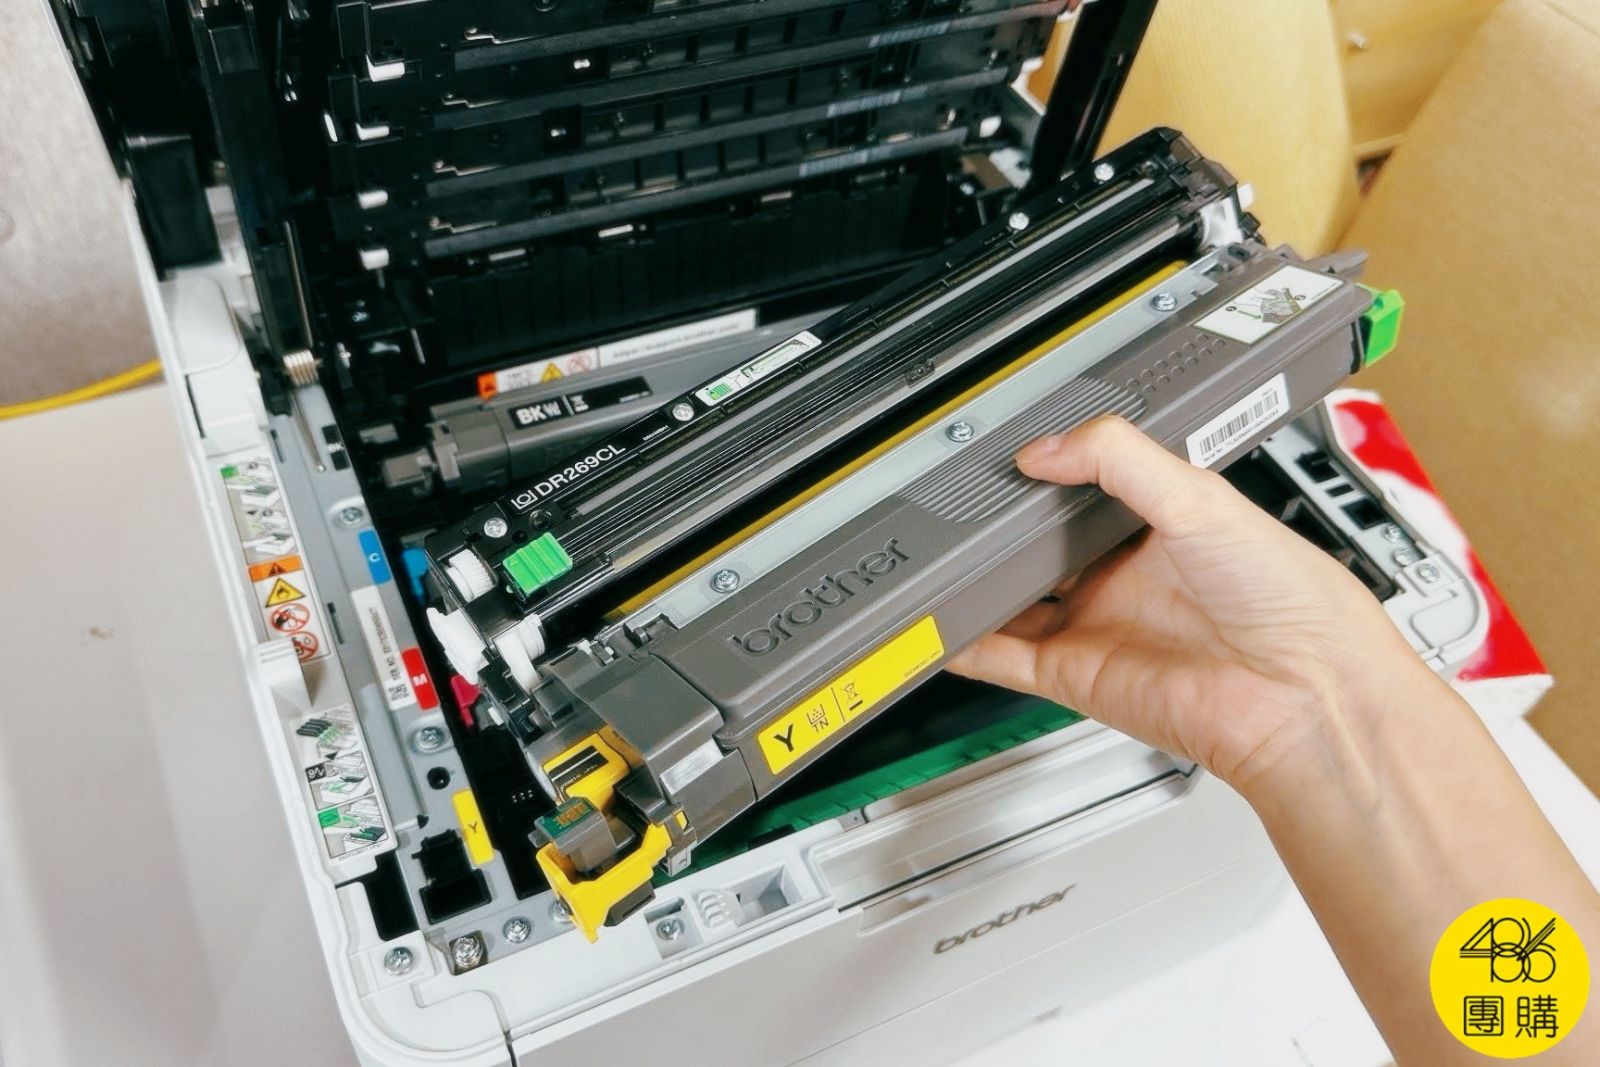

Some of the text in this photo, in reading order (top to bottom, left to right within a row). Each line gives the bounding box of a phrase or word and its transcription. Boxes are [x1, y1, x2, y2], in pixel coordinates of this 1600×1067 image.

[534, 444, 626, 496] DR269CL
[369, 553, 379, 563] C
[727, 536, 910, 655] brother
[411, 673, 427, 686] M
[773, 718, 829, 753] Y TN
[467, 822, 479, 834] Y
[933, 882, 1078, 954] brother
